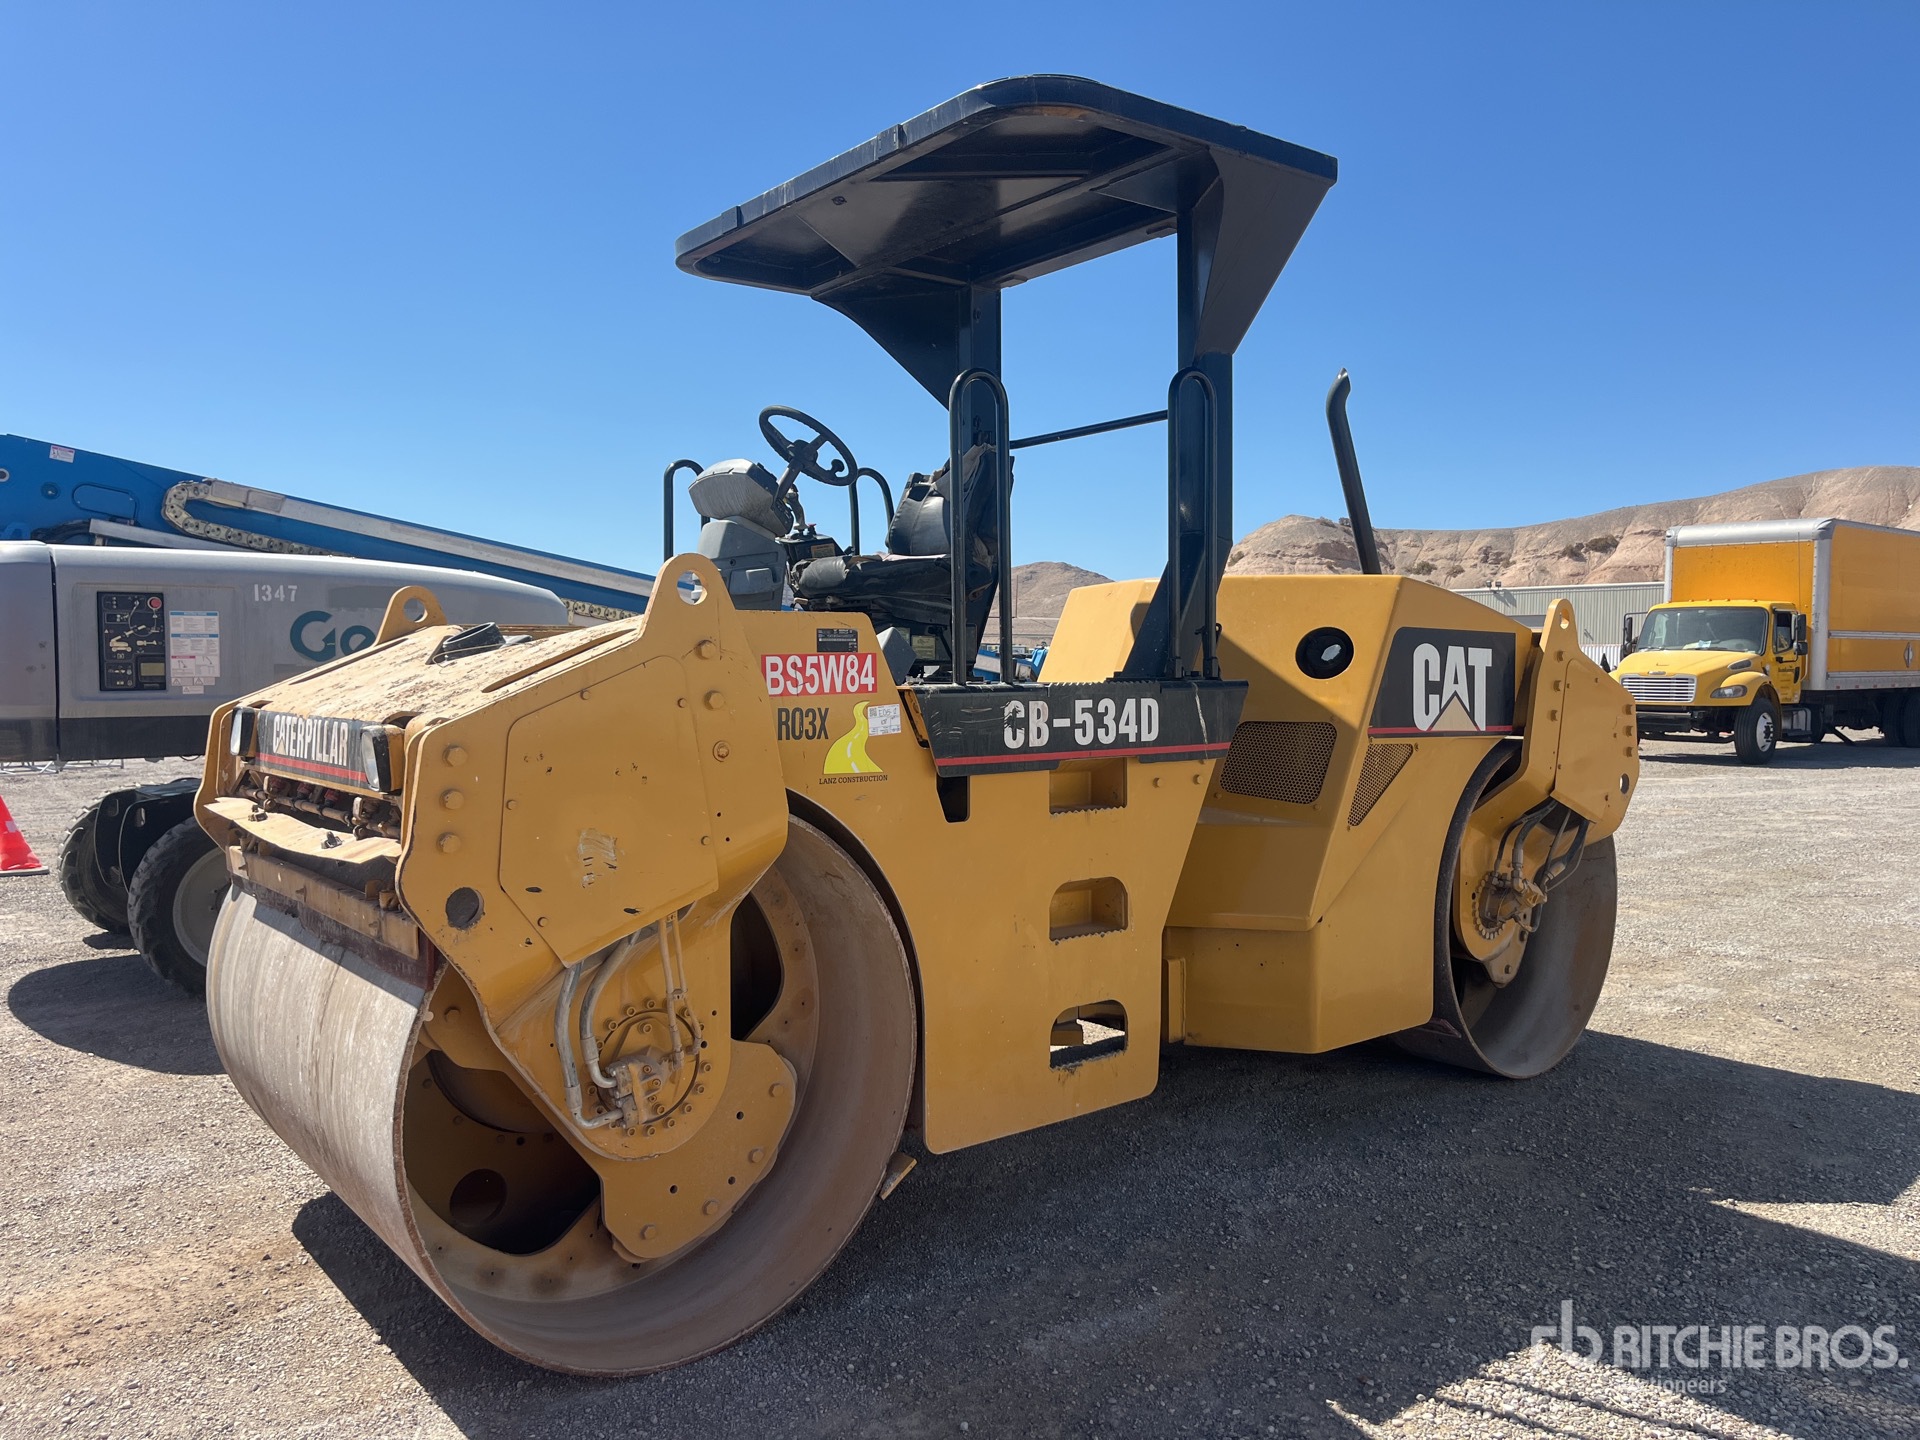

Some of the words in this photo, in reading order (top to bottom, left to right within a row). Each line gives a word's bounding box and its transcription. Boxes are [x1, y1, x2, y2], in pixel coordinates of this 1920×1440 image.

[254, 584, 298, 602] 1347
[765, 654, 875, 695] BS5W84
[1413, 643, 1492, 732] CAT
[272, 714, 349, 767] CATERPILLAR
[1003, 697, 1159, 749] CB-534D
[819, 777, 837, 785] LANZ
[838, 775, 888, 784] CONSTRUCTION
